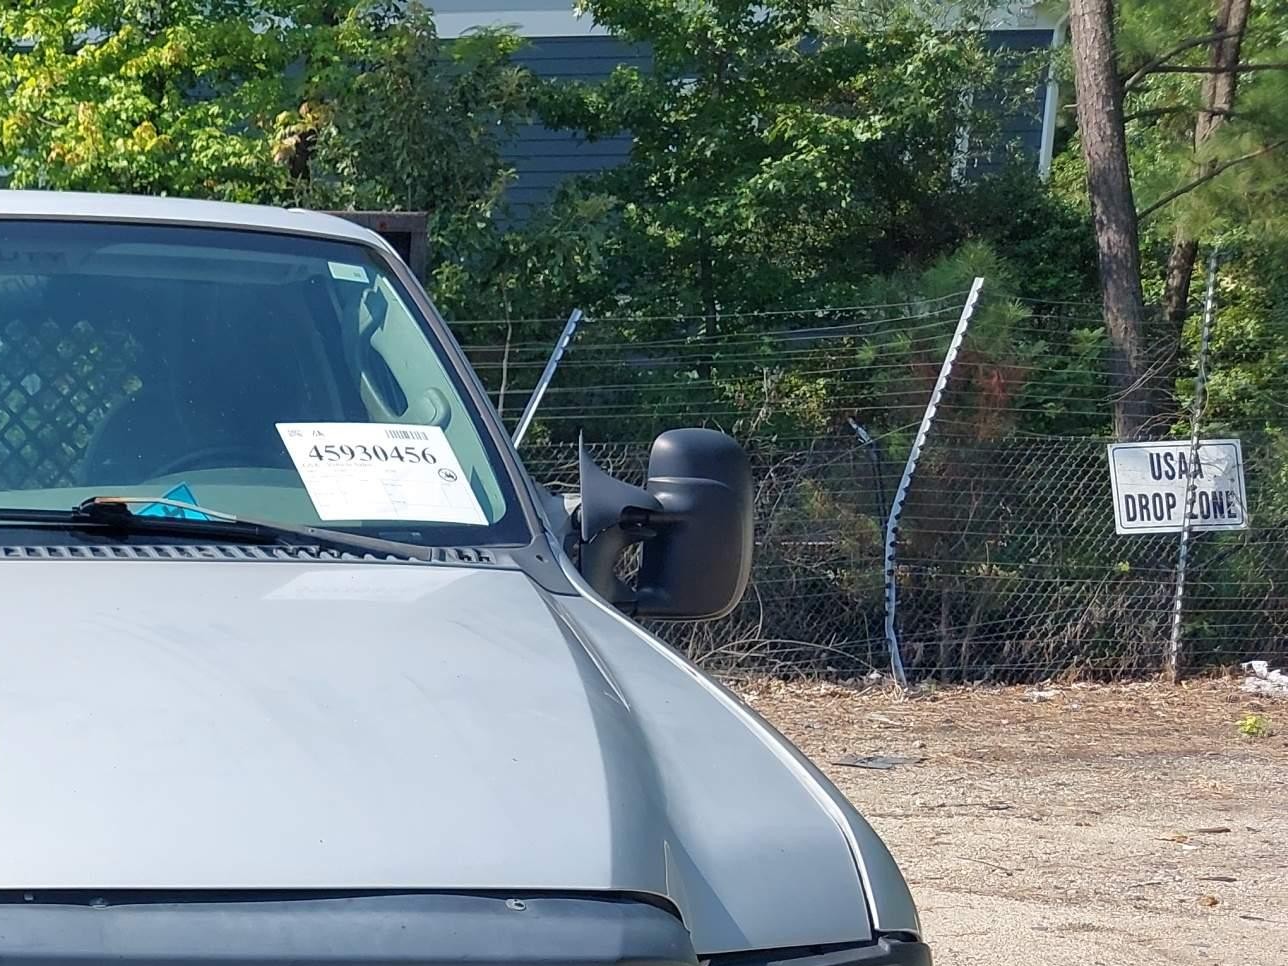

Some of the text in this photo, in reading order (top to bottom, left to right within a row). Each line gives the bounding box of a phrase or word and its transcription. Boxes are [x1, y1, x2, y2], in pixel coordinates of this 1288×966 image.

[308, 444, 438, 465] 45930456
[1149, 451, 1204, 480] USAA
[1124, 492, 1177, 522] DROP
